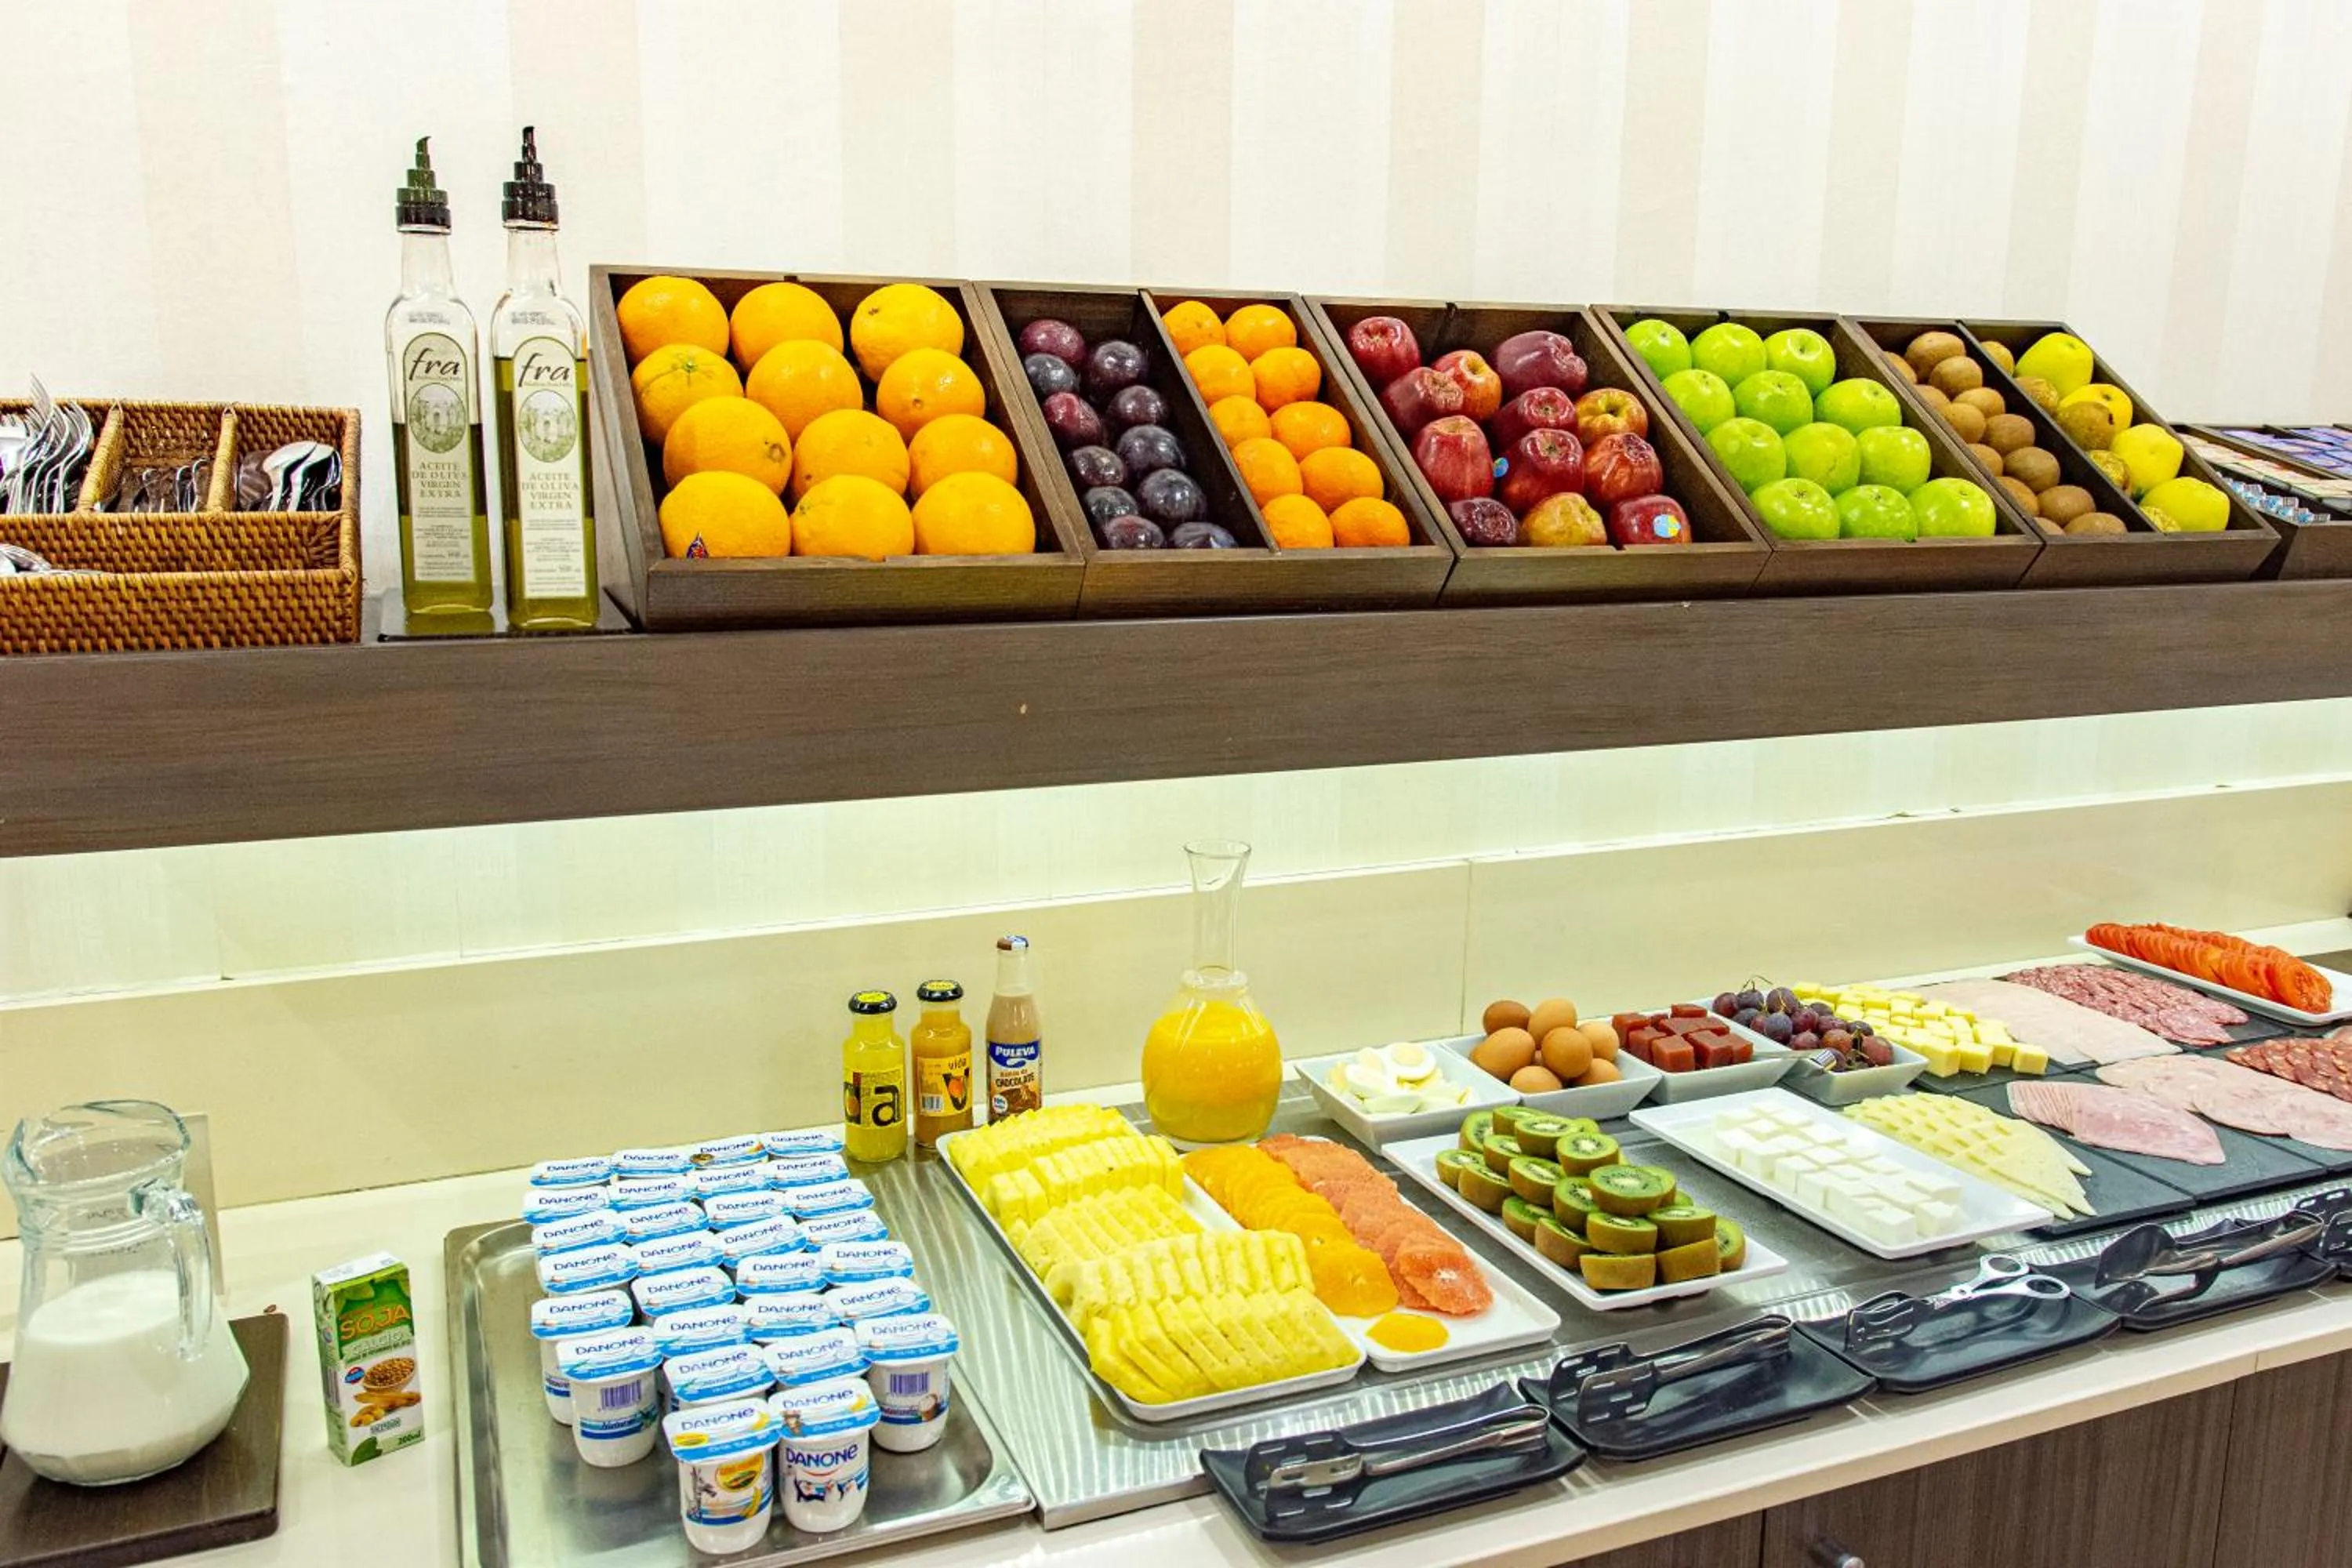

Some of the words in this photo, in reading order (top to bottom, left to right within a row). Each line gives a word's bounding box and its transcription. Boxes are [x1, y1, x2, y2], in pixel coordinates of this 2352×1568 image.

[408, 347, 460, 381] fra
[517, 352, 570, 388] fra
[419, 462, 459, 470] ACEITE
[412, 470, 427, 479] DE
[430, 470, 467, 480] OLIVA
[528, 473, 571, 481] ACEITE
[419, 480, 462, 488] VIRGEN
[521, 482, 539, 491] DE
[539, 482, 579, 491] OLIVA
[419, 489, 462, 498] EXTRA
[529, 491, 572, 500] VIRGEN
[530, 500, 573, 510] EXTRA
[995, 1045, 1036, 1058] PULEVA
[995, 1072, 1035, 1087] CHOCOLATE
[339, 1304, 412, 1341] SOJA
